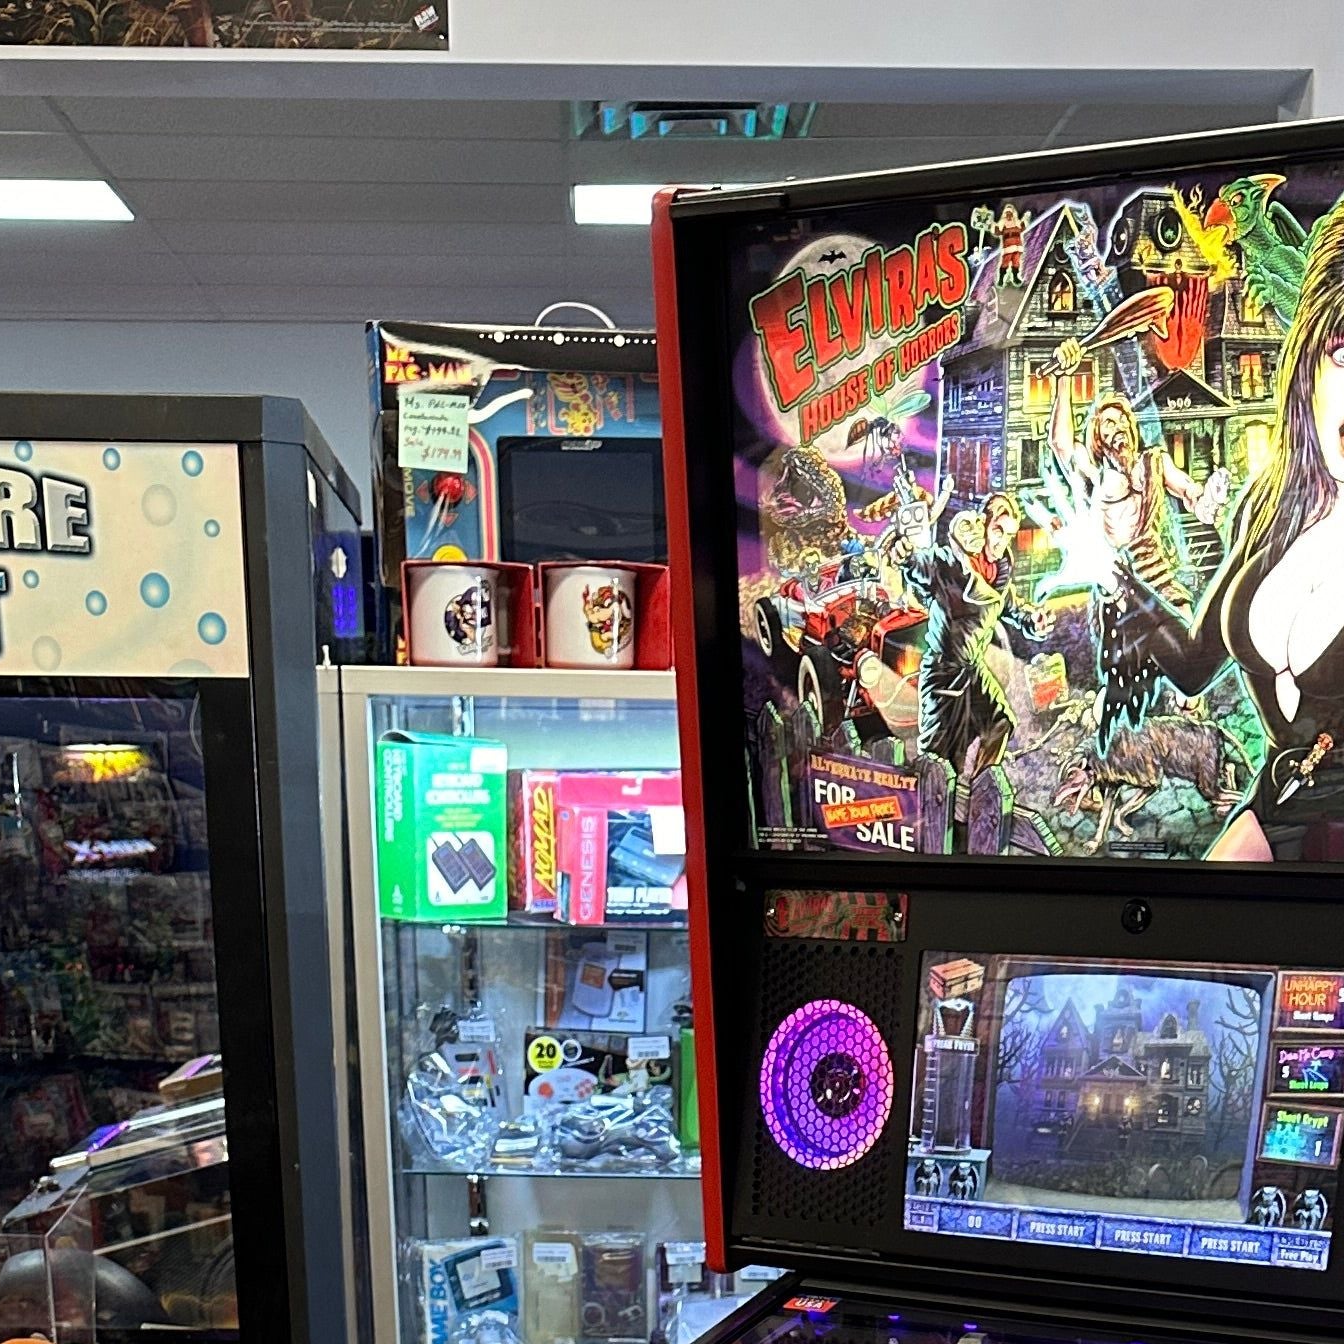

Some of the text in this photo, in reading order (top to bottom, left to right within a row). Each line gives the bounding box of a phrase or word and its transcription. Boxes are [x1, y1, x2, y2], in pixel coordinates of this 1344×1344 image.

[752, 223, 968, 409] ELVIRA'S
[385, 361, 475, 385] PAC-MAN
[801, 313, 962, 443] HOUSE OF HORRORS
[814, 779, 856, 805] FOR
[532, 785, 557, 896] NOMAD
[856, 821, 916, 852] SALE
[580, 816, 598, 920] GENESIS
[1284, 979, 1337, 994] UNHAPPY
[1288, 992, 1327, 1007] HOUR
[534, 1043, 557, 1060] 20
[1030, 1222, 1086, 1238] PRESS START
[1114, 1230, 1172, 1246] PRESS START
[1201, 1237, 1259, 1253] PRESS START
[430, 1259, 449, 1299] BOY
